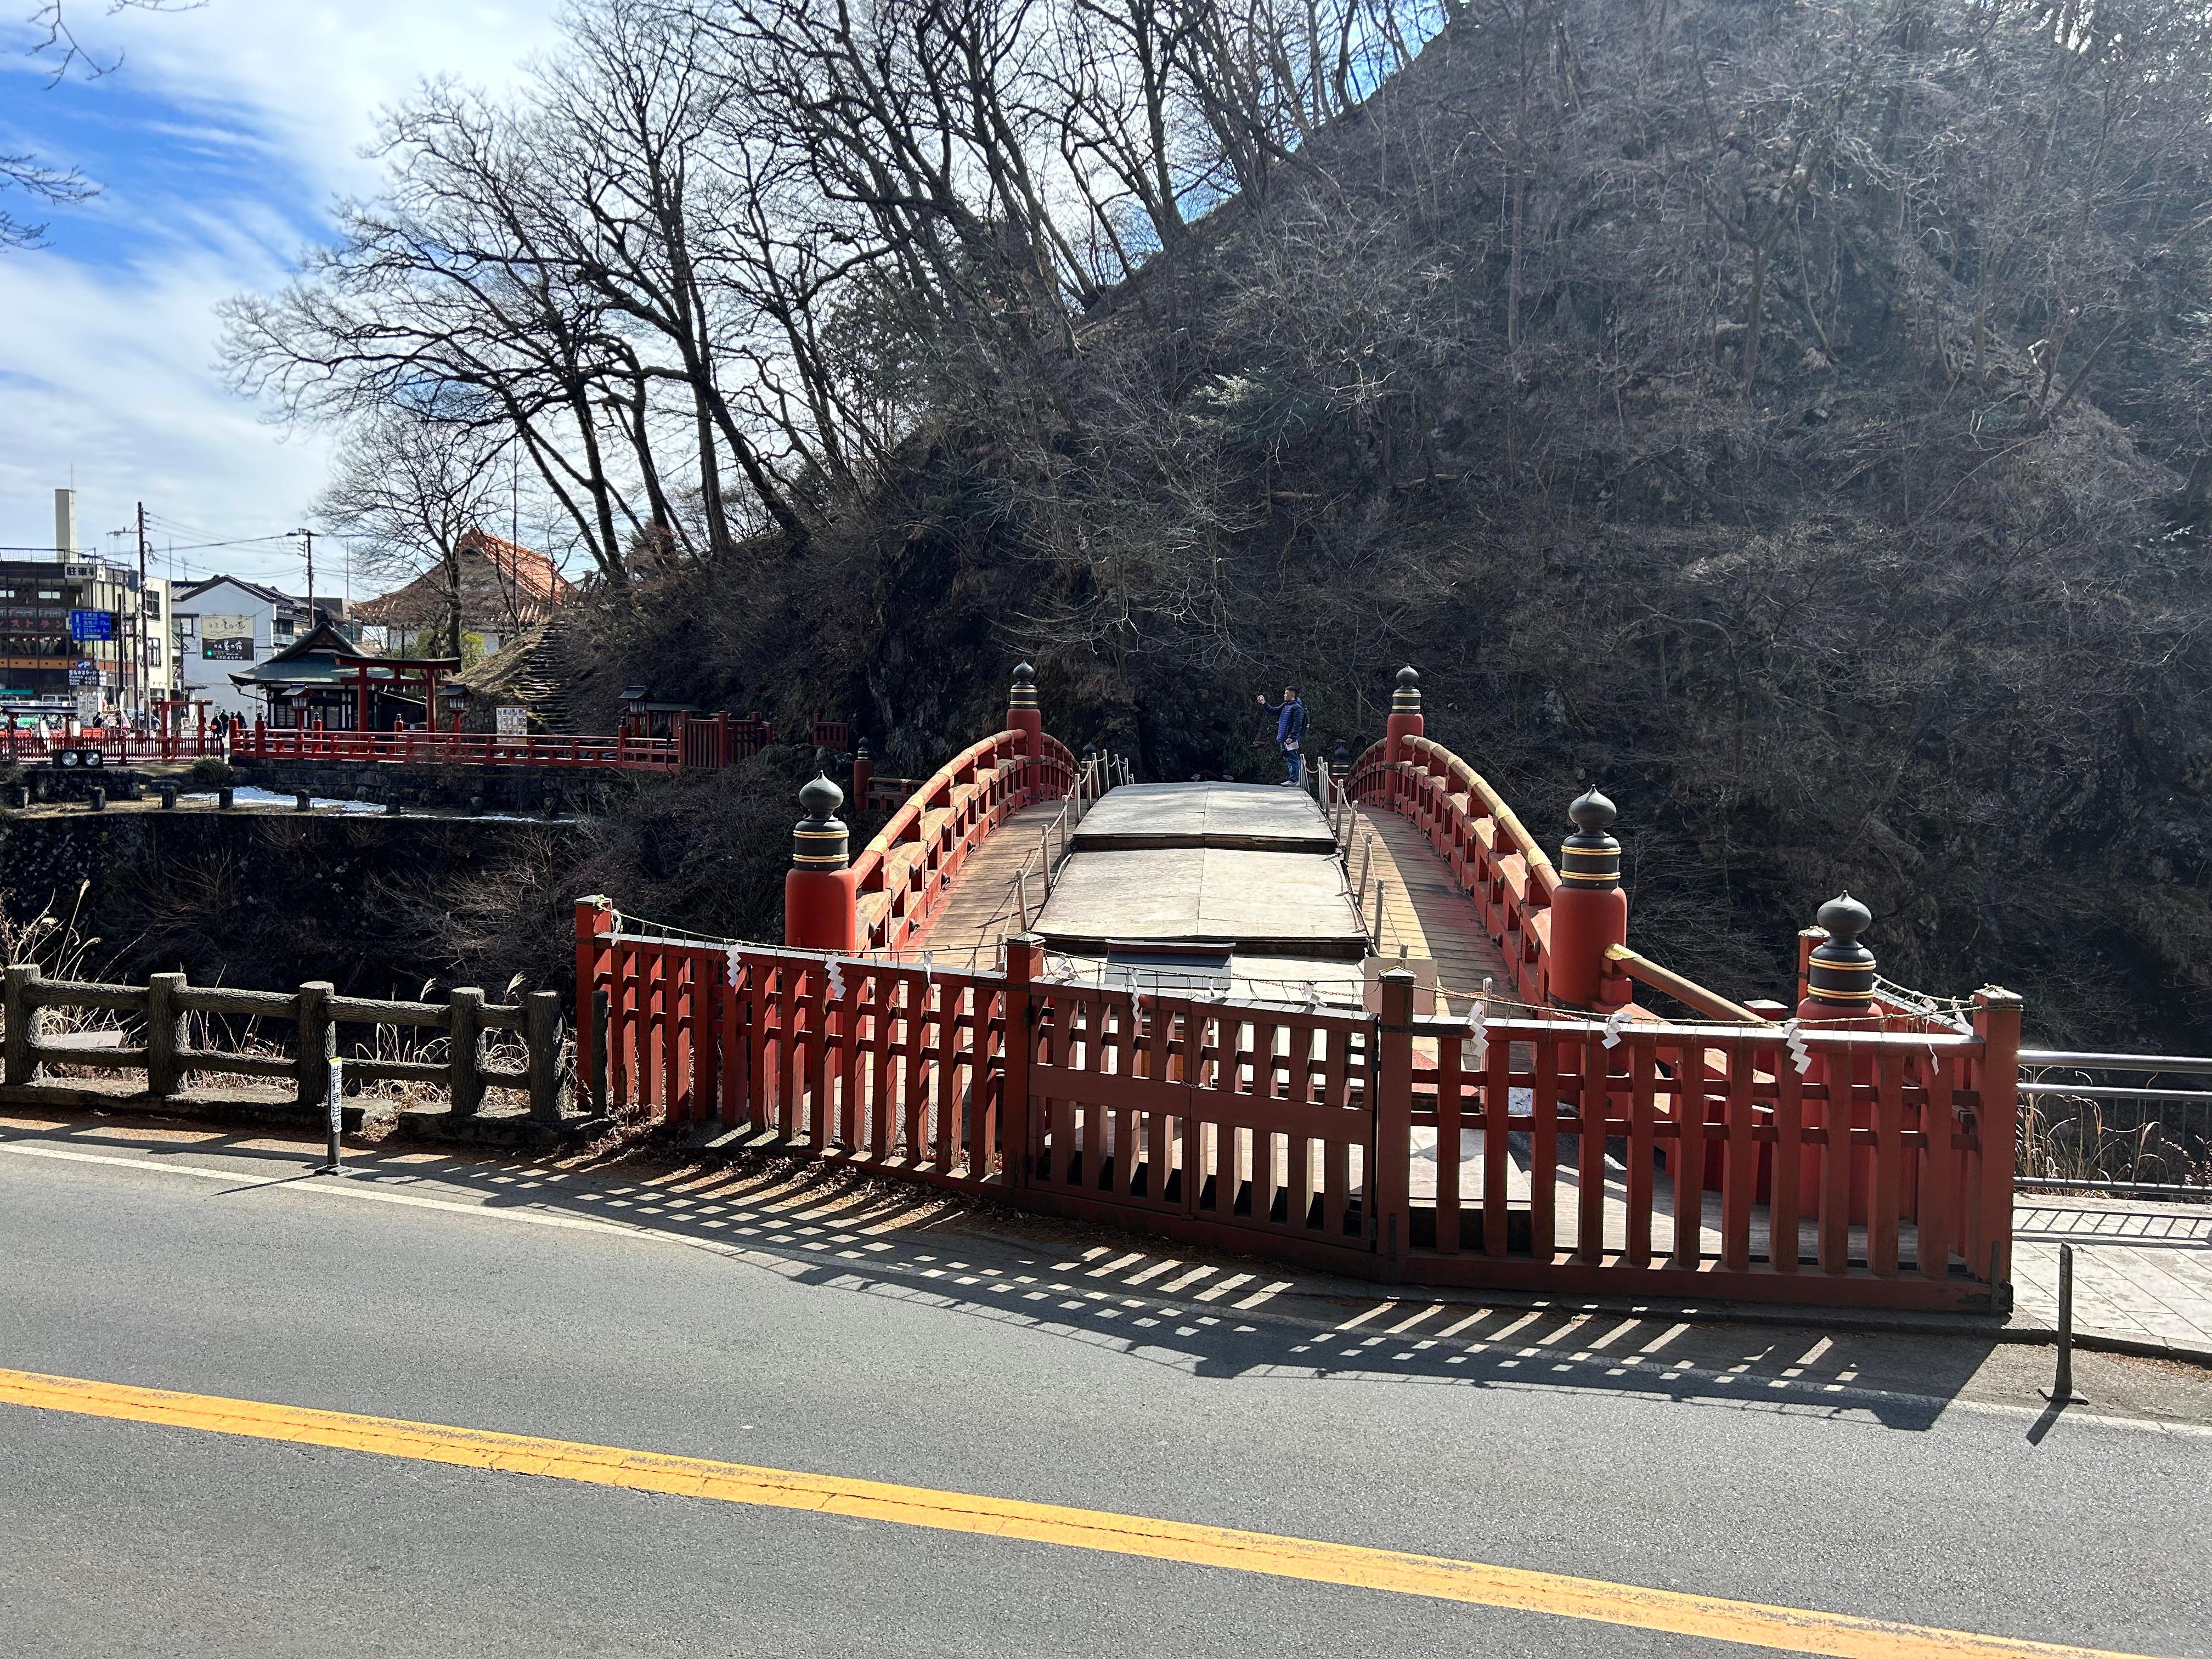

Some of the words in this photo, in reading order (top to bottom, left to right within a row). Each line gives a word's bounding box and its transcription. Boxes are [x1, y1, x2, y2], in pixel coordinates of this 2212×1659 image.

[331, 1064, 342, 1131] 歩行者注意
